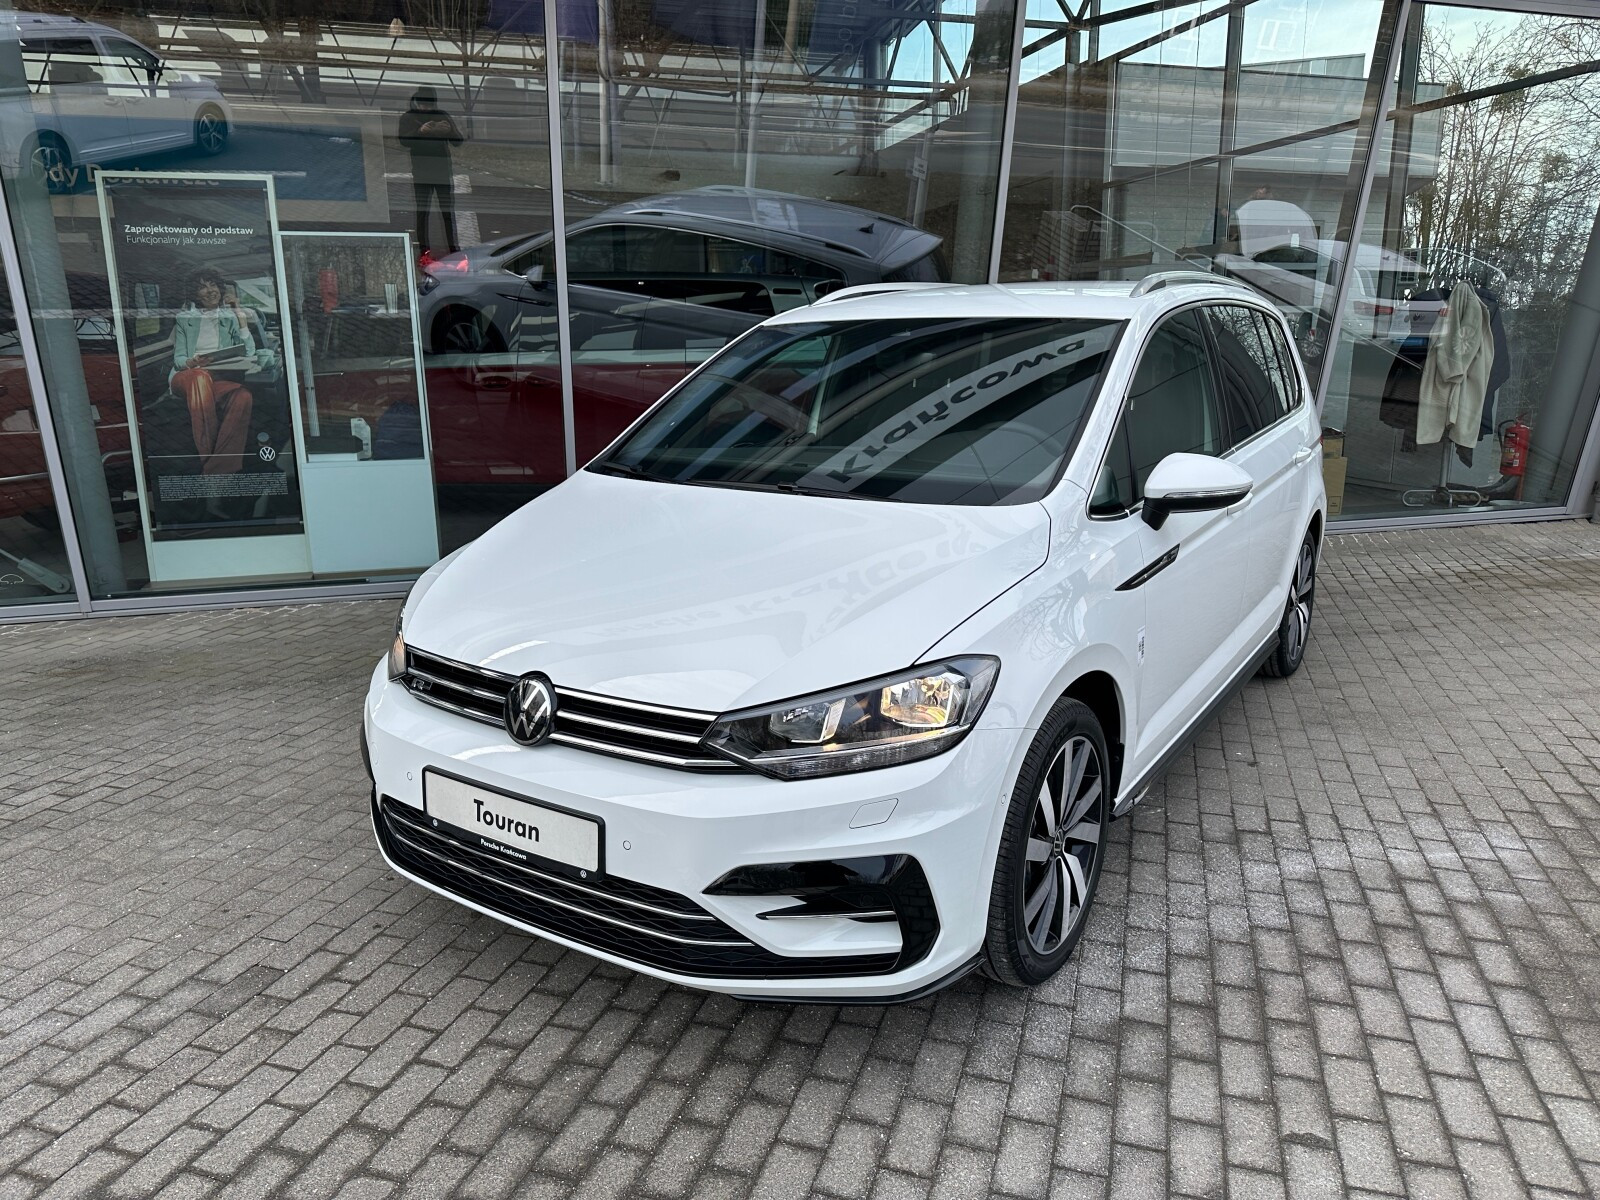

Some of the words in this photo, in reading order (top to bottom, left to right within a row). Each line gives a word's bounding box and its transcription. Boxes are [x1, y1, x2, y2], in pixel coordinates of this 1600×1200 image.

[124, 225, 199, 235] Zaprojektowany
[200, 225, 212, 234] od
[214, 226, 254, 235] podstaw
[126, 235, 180, 245] Funkcjonalny
[182, 235, 194, 245] jak
[473, 798, 540, 842] Touran
[480, 838, 500, 851] Porsche
